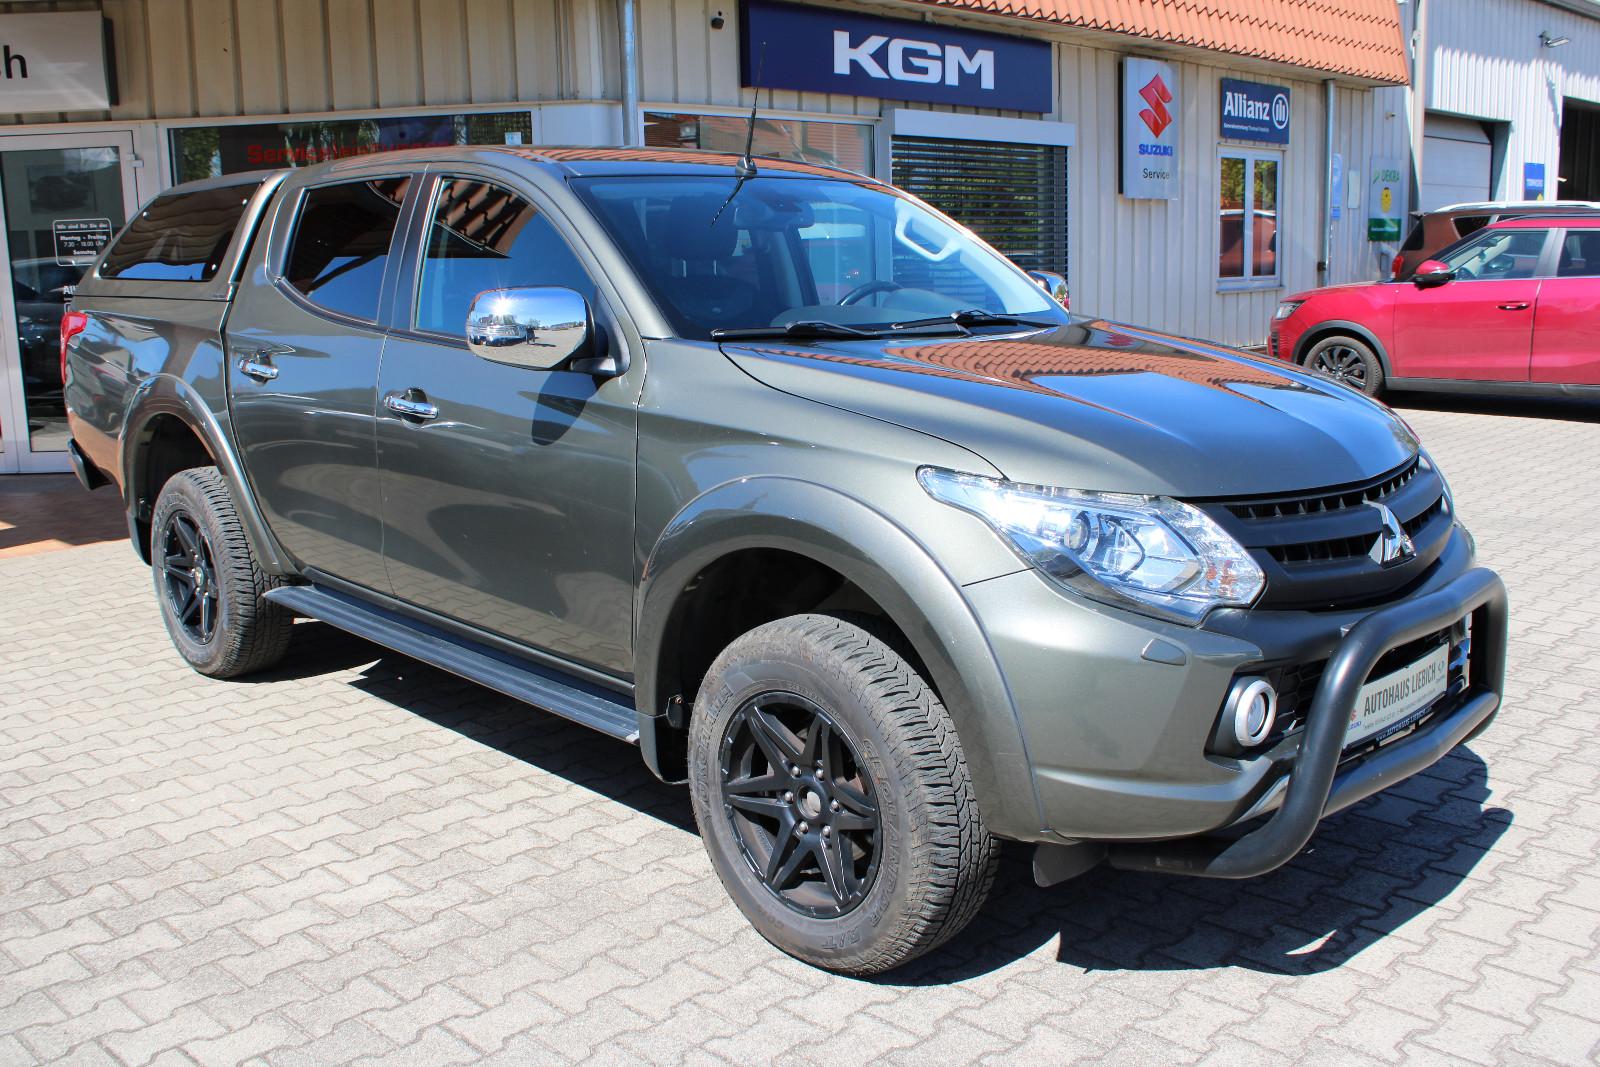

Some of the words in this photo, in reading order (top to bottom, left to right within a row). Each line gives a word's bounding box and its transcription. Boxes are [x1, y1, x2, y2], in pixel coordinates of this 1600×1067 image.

[833, 30, 995, 90] KGM
[1224, 91, 1270, 121] Allianz
[1138, 143, 1173, 157] SUZUKI
[1142, 167, 1170, 180] Service
[1381, 168, 1400, 183] DEKRA
[1364, 677, 1410, 717] AUTOHAUS
[1411, 662, 1436, 694] LIEBICH
